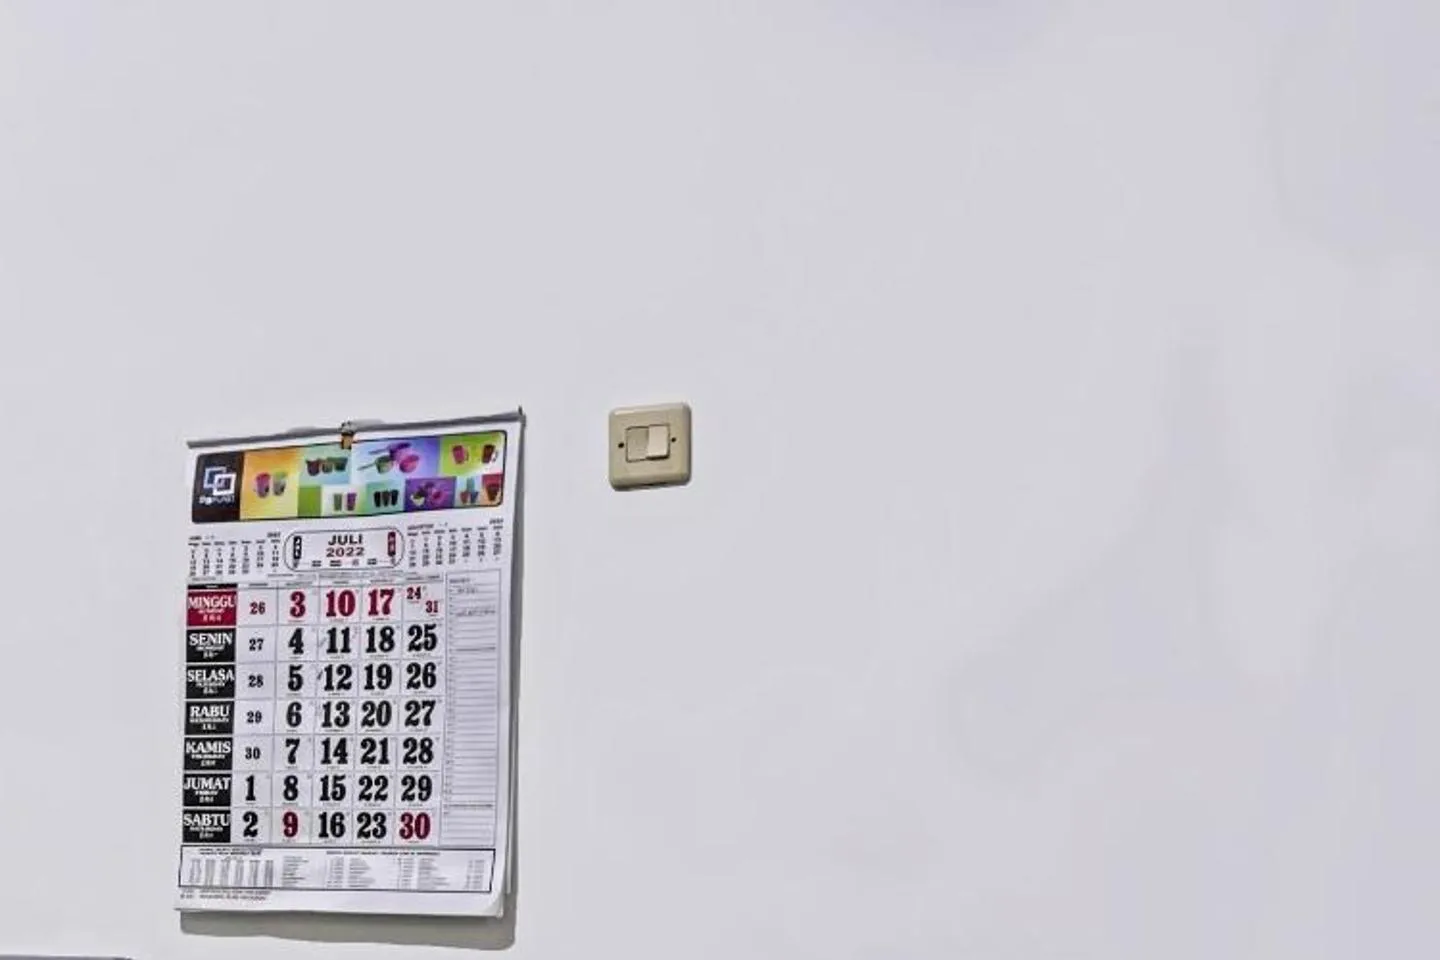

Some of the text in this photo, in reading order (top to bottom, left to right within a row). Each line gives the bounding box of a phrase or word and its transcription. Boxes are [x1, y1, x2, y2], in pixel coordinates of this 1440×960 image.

[325, 546, 365, 558] 2022
[327, 533, 363, 546] JULI
[188, 594, 237, 609] MINGGU
[249, 601, 266, 615] 26
[289, 590, 307, 619] 3
[325, 589, 356, 618] 10
[367, 587, 395, 617] 17
[406, 586, 422, 600] 24
[425, 599, 439, 614] 31
[189, 632, 233, 646] SENIN
[248, 637, 264, 652] 27
[287, 627, 305, 655] 4
[325, 626, 352, 655] 11
[365, 625, 396, 654] 18
[407, 623, 438, 653] 25
[187, 668, 235, 682] SELASA
[287, 664, 304, 692] 5
[323, 663, 353, 692] 12
[363, 662, 393, 691] 19
[406, 661, 437, 690] 26
[190, 704, 230, 717] RABU
[246, 710, 263, 724] 29
[285, 701, 303, 728] 6
[321, 700, 351, 729] 13
[360, 700, 393, 728] 20
[404, 699, 437, 727] 27
[185, 736, 434, 765] KAMIS 30 7 14 21 28
[183, 776, 231, 790] JUMAT
[245, 774, 257, 802] 1
[282, 774, 299, 802] 8
[319, 774, 347, 802] 15
[358, 774, 389, 802] 22
[400, 774, 433, 802] 29
[183, 813, 230, 826] SABTU
[242, 810, 259, 838] 2
[281, 810, 299, 839] 9
[318, 811, 346, 839] 16
[356, 811, 387, 840] 23
[398, 811, 431, 840] 30
